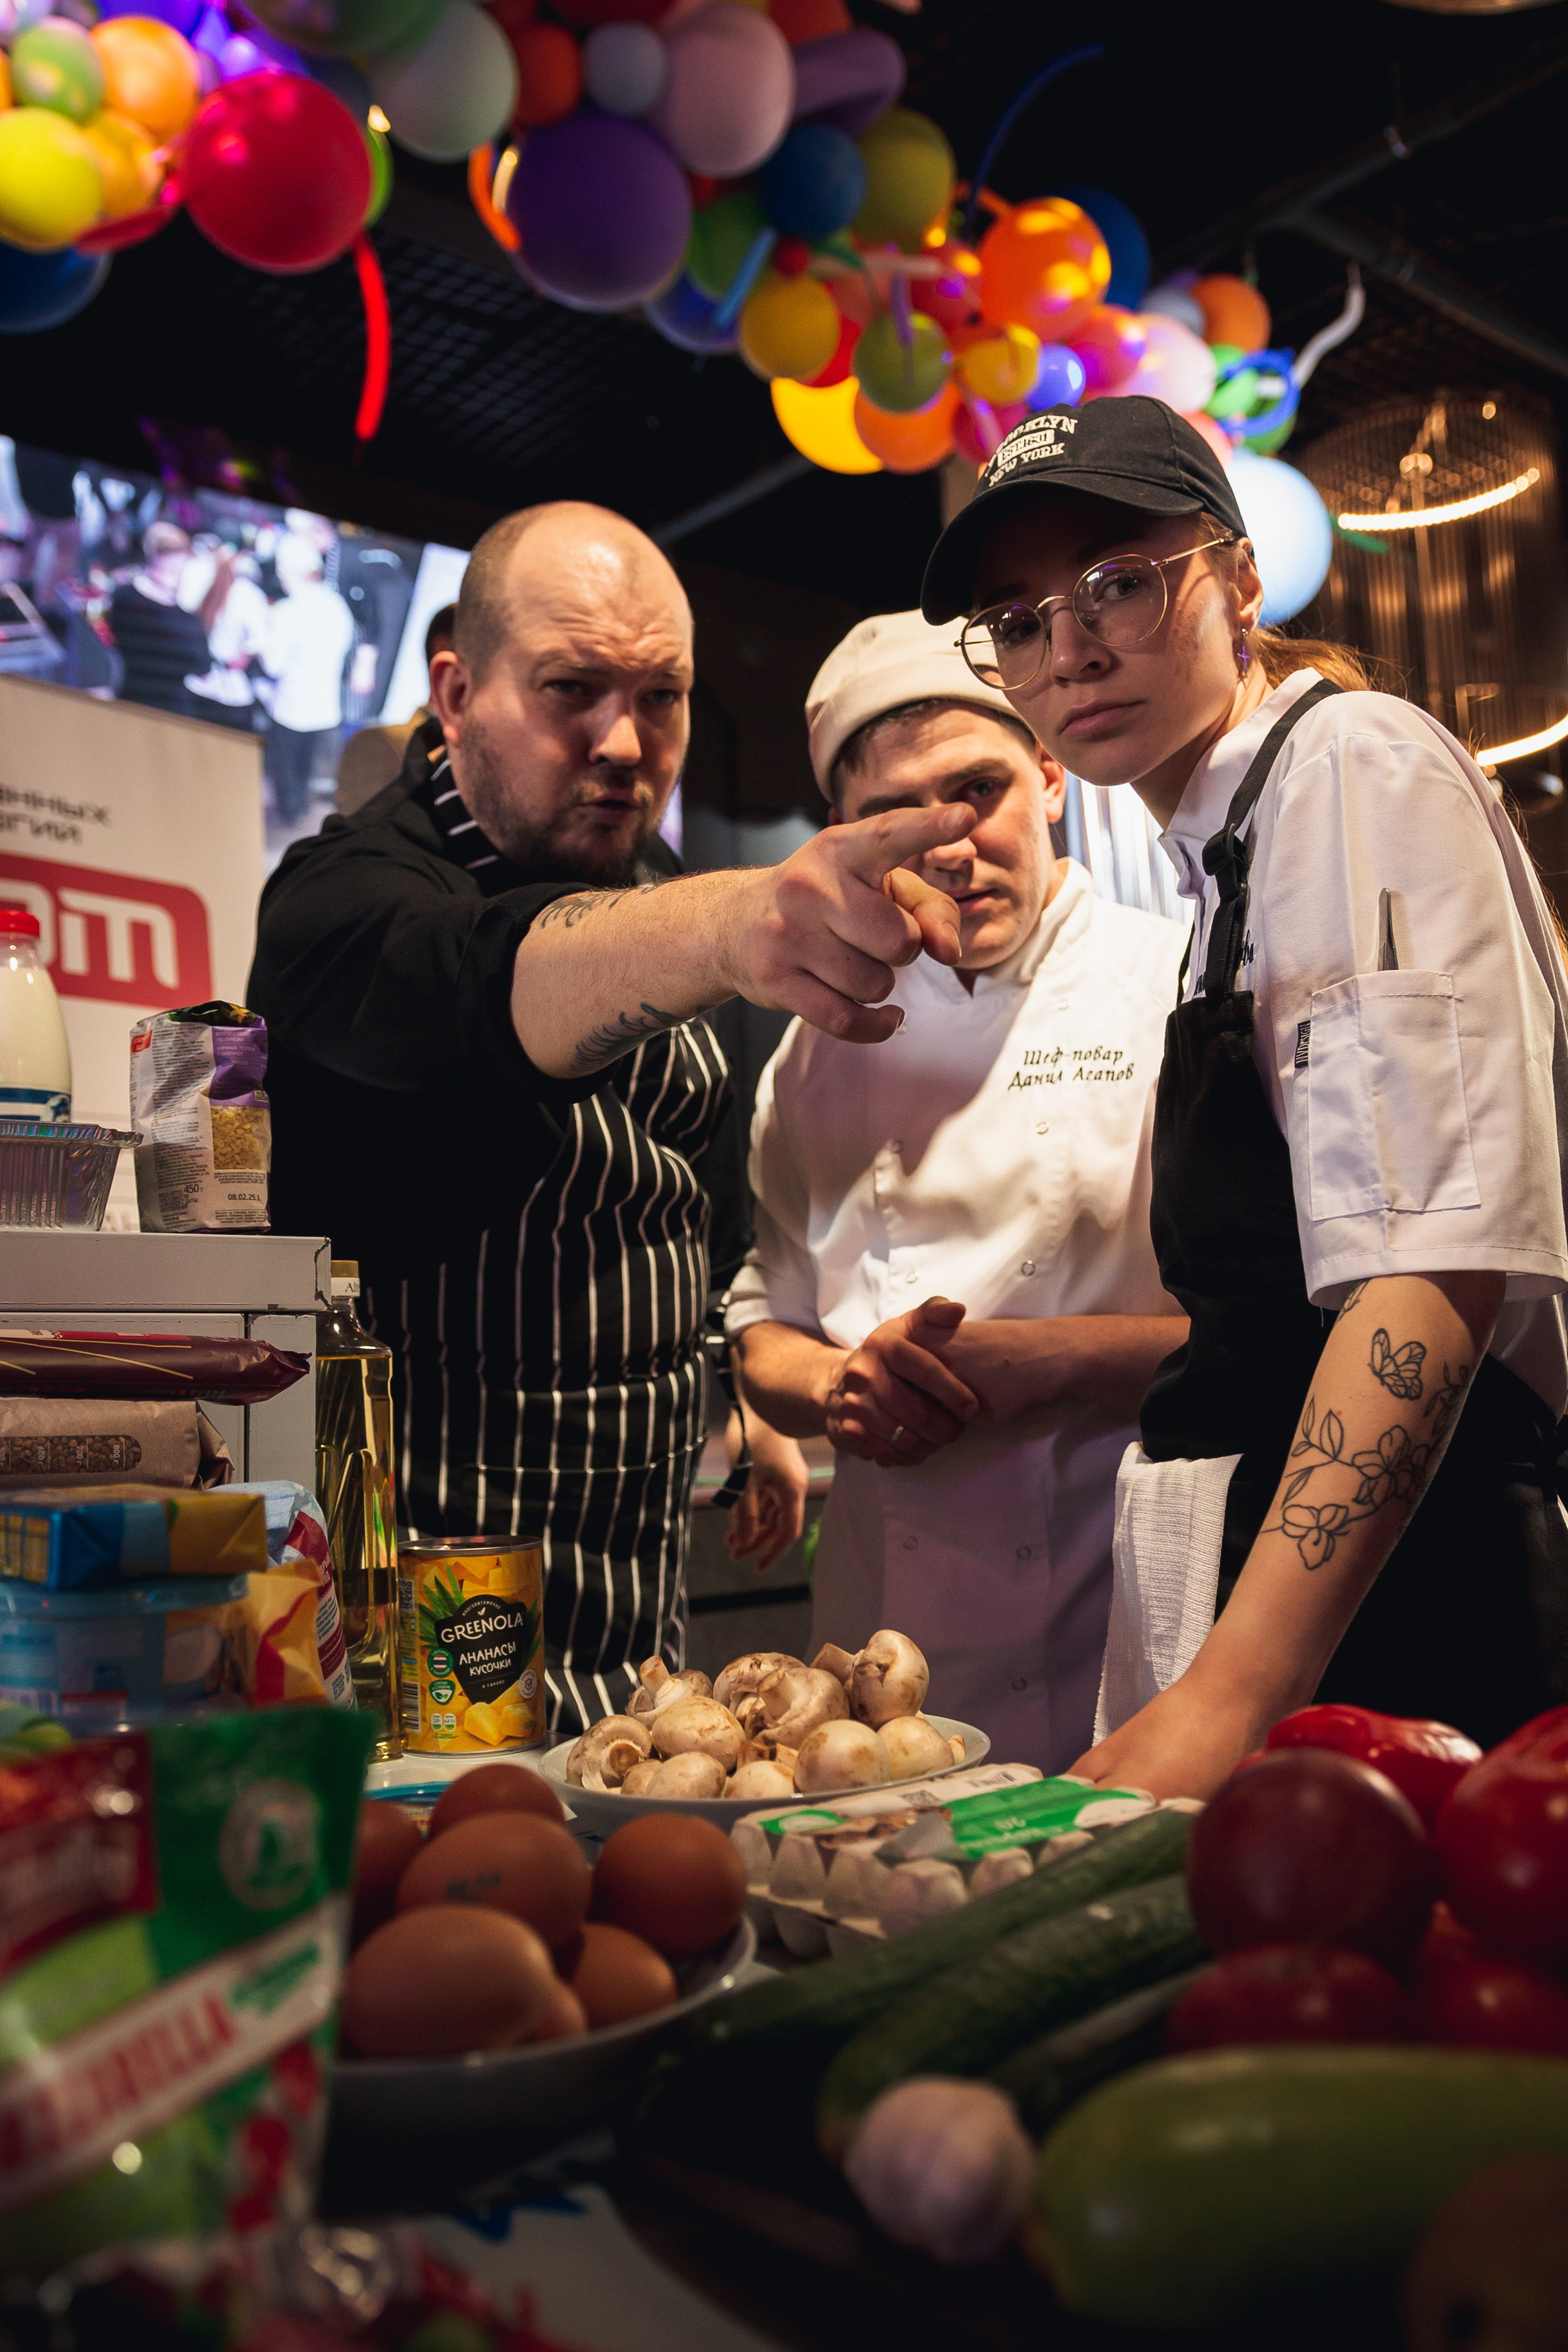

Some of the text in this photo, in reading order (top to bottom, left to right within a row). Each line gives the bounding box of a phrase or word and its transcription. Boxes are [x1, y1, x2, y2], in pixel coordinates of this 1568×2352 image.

[988, 458, 1018, 487] NEW
[1020, 443, 1065, 464] YORK
[0, 783, 111, 826] нных
[1023, 1046, 1123, 1067] Шеф-повар
[1008, 1063, 1134, 1091] Данил Агапов
[184, 1183, 199, 1194] 450
[440, 1612, 523, 1643] GREENOLA
[459, 1642, 516, 1665] АНАНАСЫ
[470, 1658, 511, 1676] КУСОЧКИ
